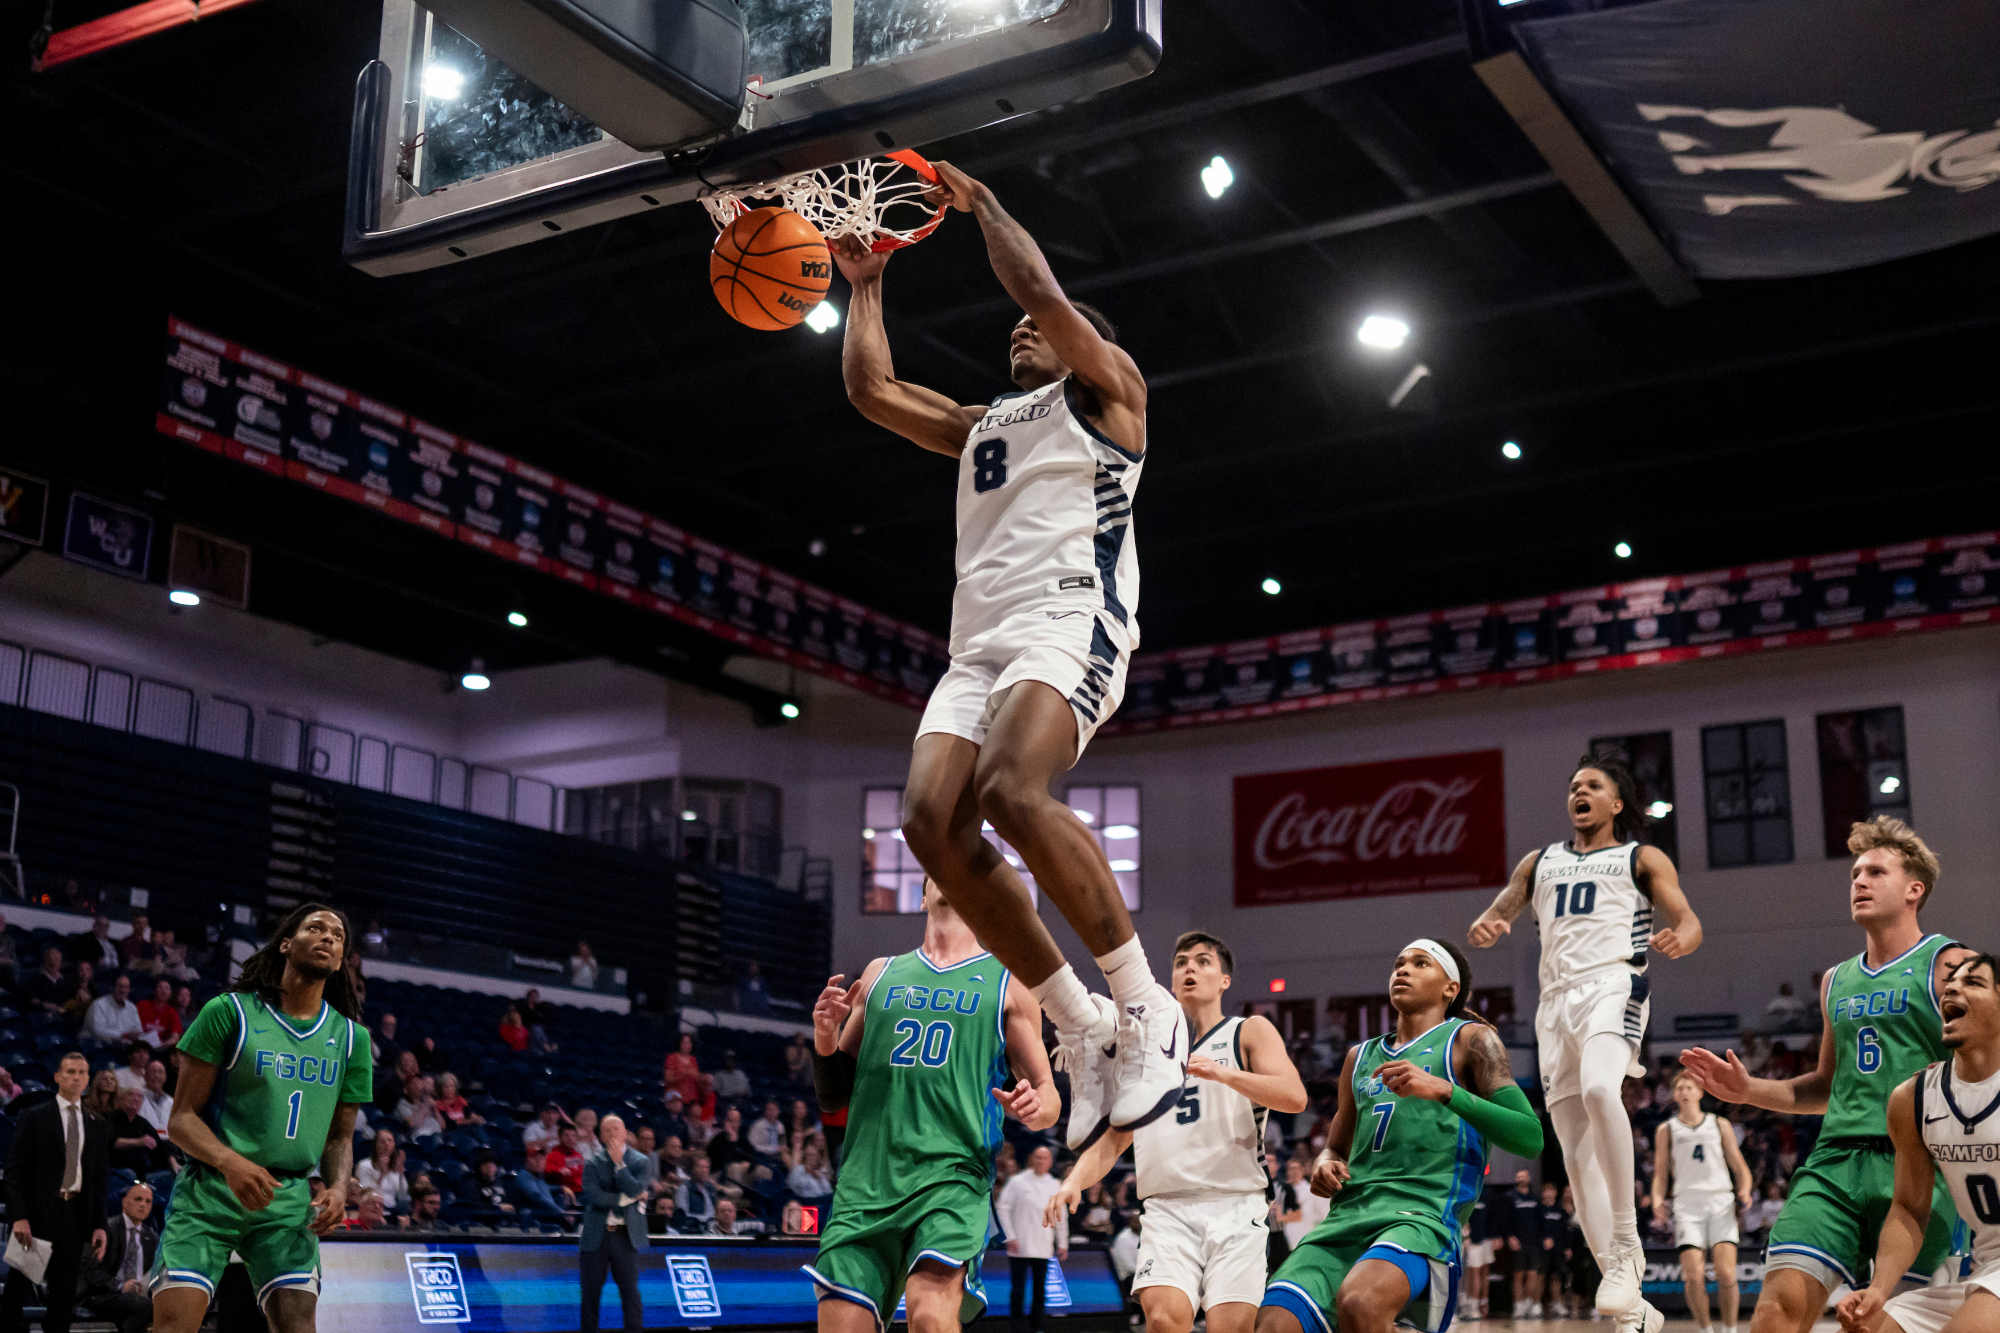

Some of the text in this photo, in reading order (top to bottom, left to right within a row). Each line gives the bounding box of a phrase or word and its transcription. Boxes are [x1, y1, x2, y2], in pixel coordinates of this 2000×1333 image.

[801, 260, 830, 280] CAA
[973, 436, 1009, 496] 8
[1254, 777, 1478, 869] Coca-Cola
[1541, 864, 1624, 882] SAMFORD
[1554, 881, 1597, 918] 10
[883, 985, 982, 1016] FGCU
[1834, 988, 1910, 1025] FGCU
[889, 1017, 954, 1068] 20
[1856, 1025, 1883, 1075] 6
[255, 1049, 340, 1088] FGCU
[285, 1090, 303, 1139] 1
[1175, 1085, 1201, 1126] 5
[1371, 1101, 1396, 1153] 7
[1692, 1144, 1706, 1163] 4
[1930, 1143, 2000, 1162] SAMFO
[1965, 1173, 2000, 1225] 0
